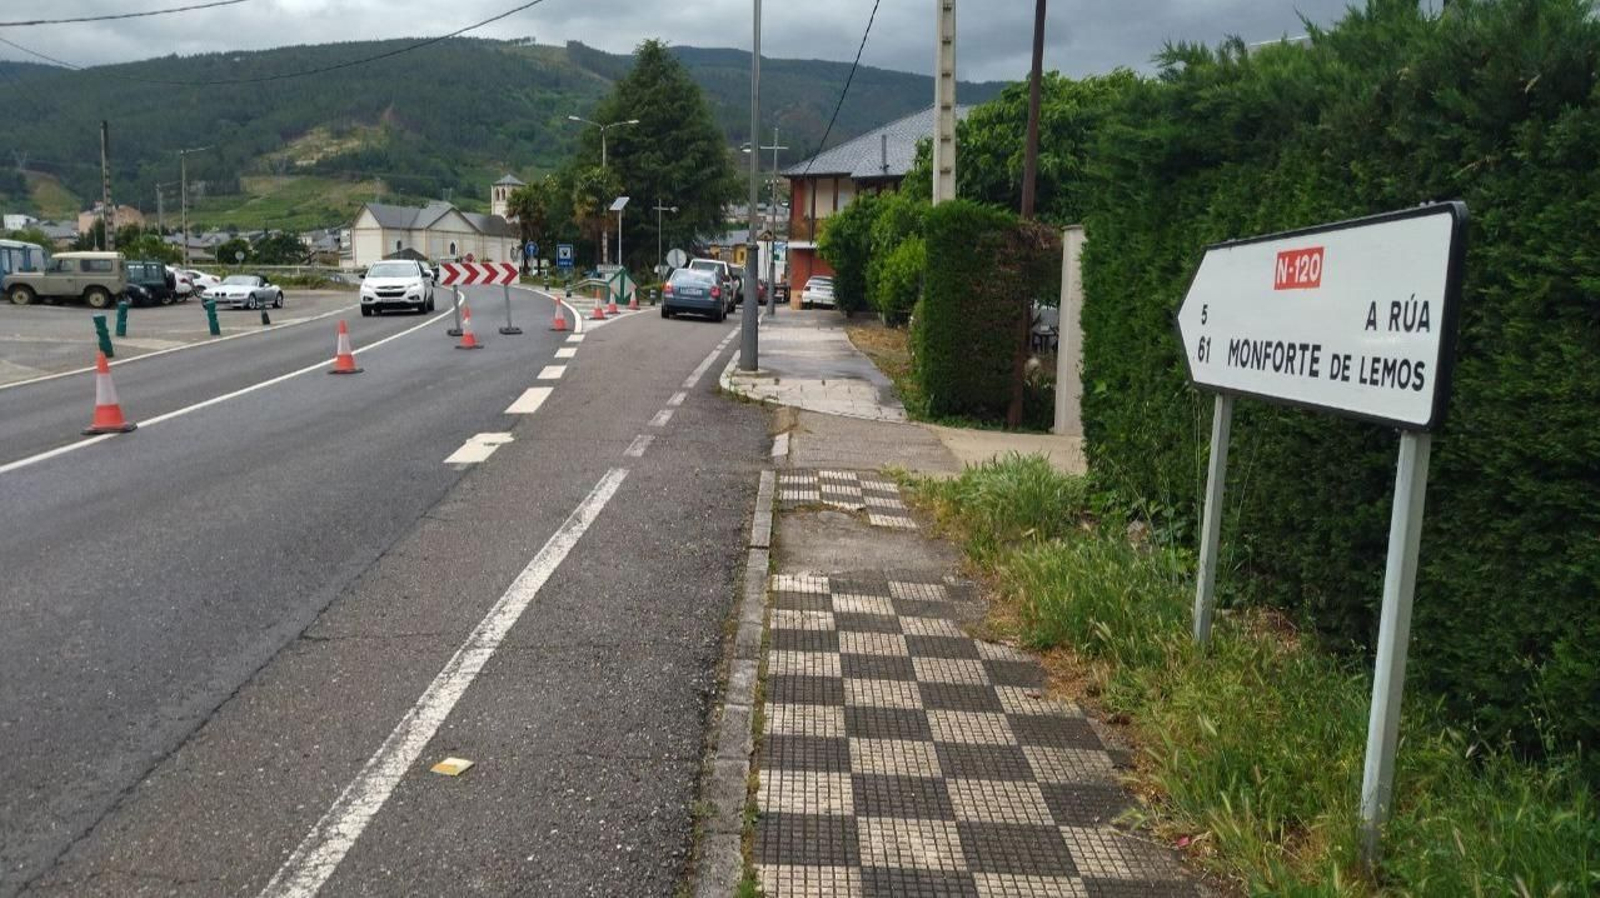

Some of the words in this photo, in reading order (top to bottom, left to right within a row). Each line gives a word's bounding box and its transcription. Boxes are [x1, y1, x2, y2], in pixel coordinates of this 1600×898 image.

[1276, 252, 1320, 284] N-120
[1201, 304, 1208, 325] 5
[1365, 301, 1377, 331] A
[1388, 294, 1430, 333] RÚA
[1197, 336, 1211, 363] 61
[1228, 338, 1321, 377] MONFORTE
[1329, 353, 1351, 382] DE
[1359, 356, 1425, 391] LEMOS
